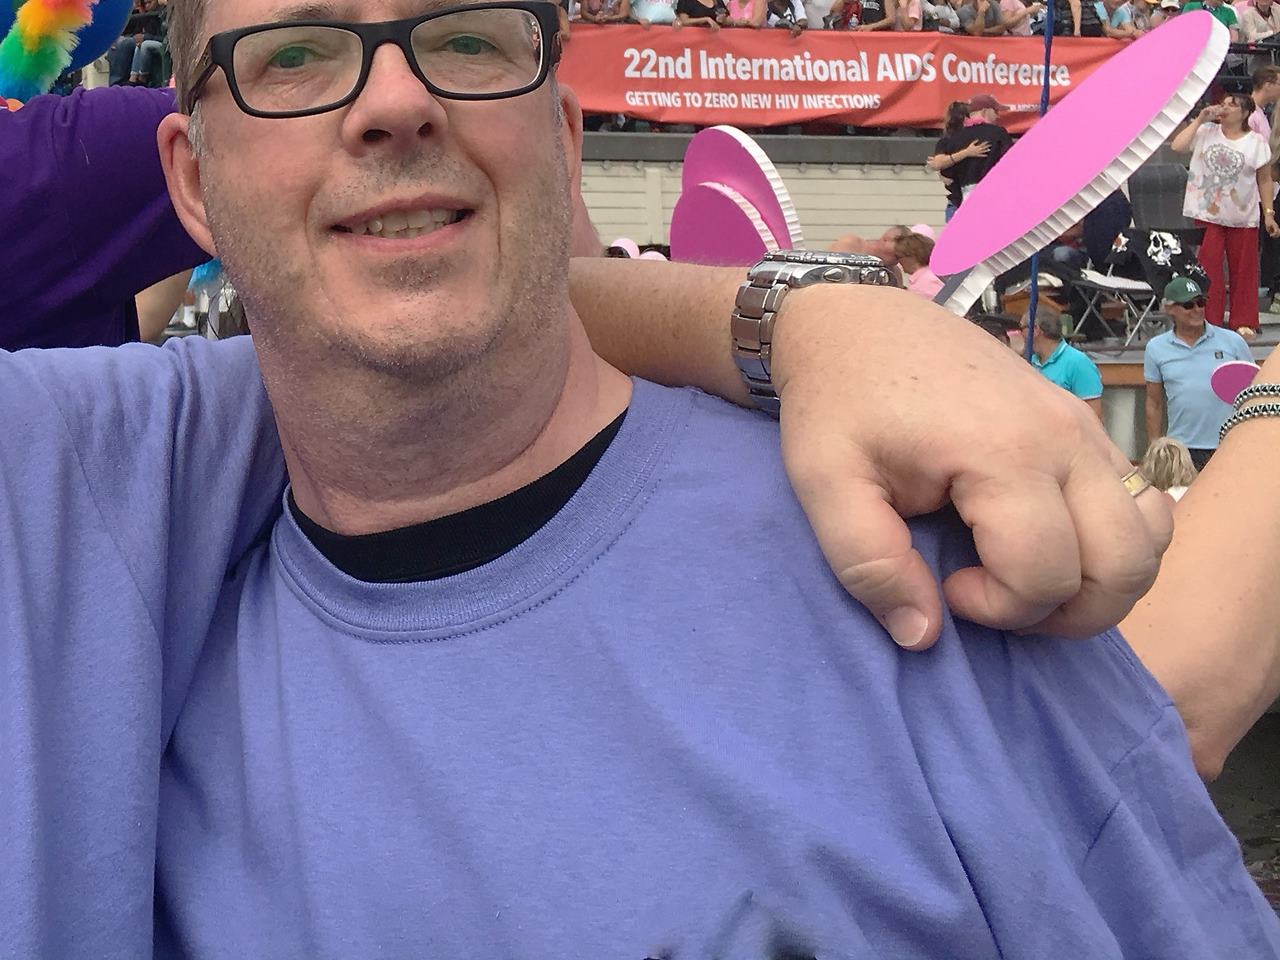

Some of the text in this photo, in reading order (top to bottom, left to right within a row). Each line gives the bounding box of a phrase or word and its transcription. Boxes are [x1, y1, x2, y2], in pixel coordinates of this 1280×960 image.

[623, 47, 1072, 87] 22nd International AIDS Conference
[625, 90, 881, 110] GETTING TO ZERO NEW HIV INFECTIONS
